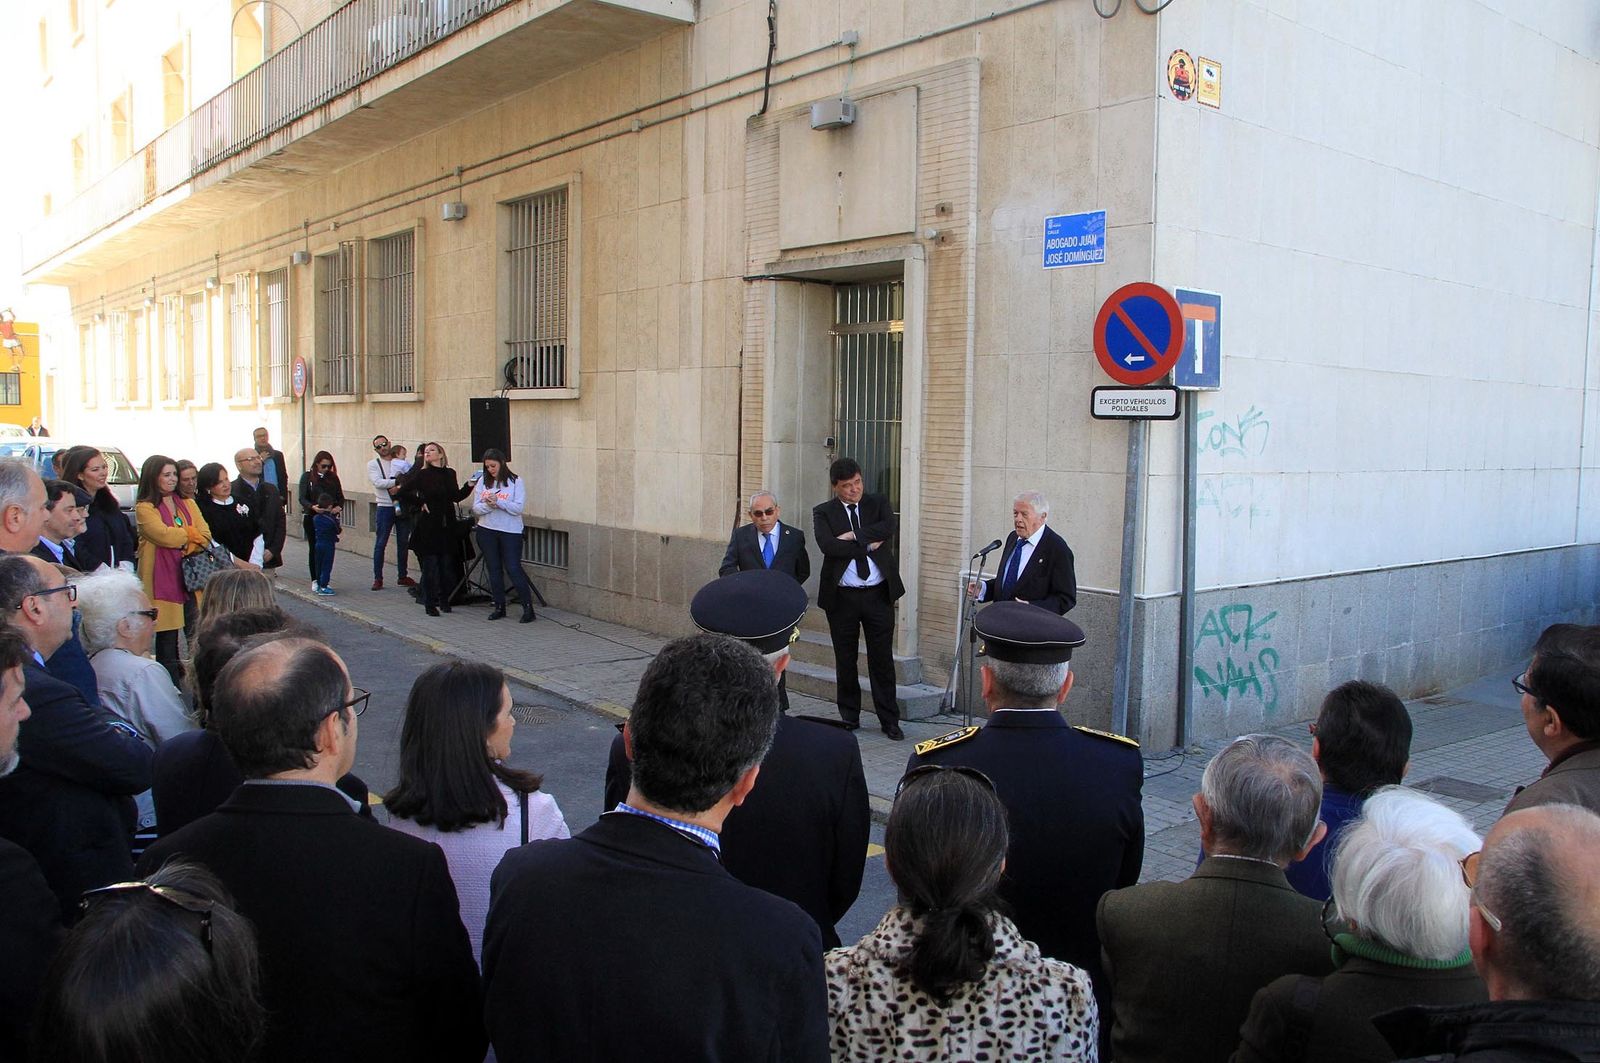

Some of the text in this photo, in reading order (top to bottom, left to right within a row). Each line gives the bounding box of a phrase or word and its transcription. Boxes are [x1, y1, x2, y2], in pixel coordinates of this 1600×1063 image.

[1046, 235, 1096, 249] ABOGADO JUAN
[1046, 249, 1102, 264] JOSÉ DOMÍNGUEZ
